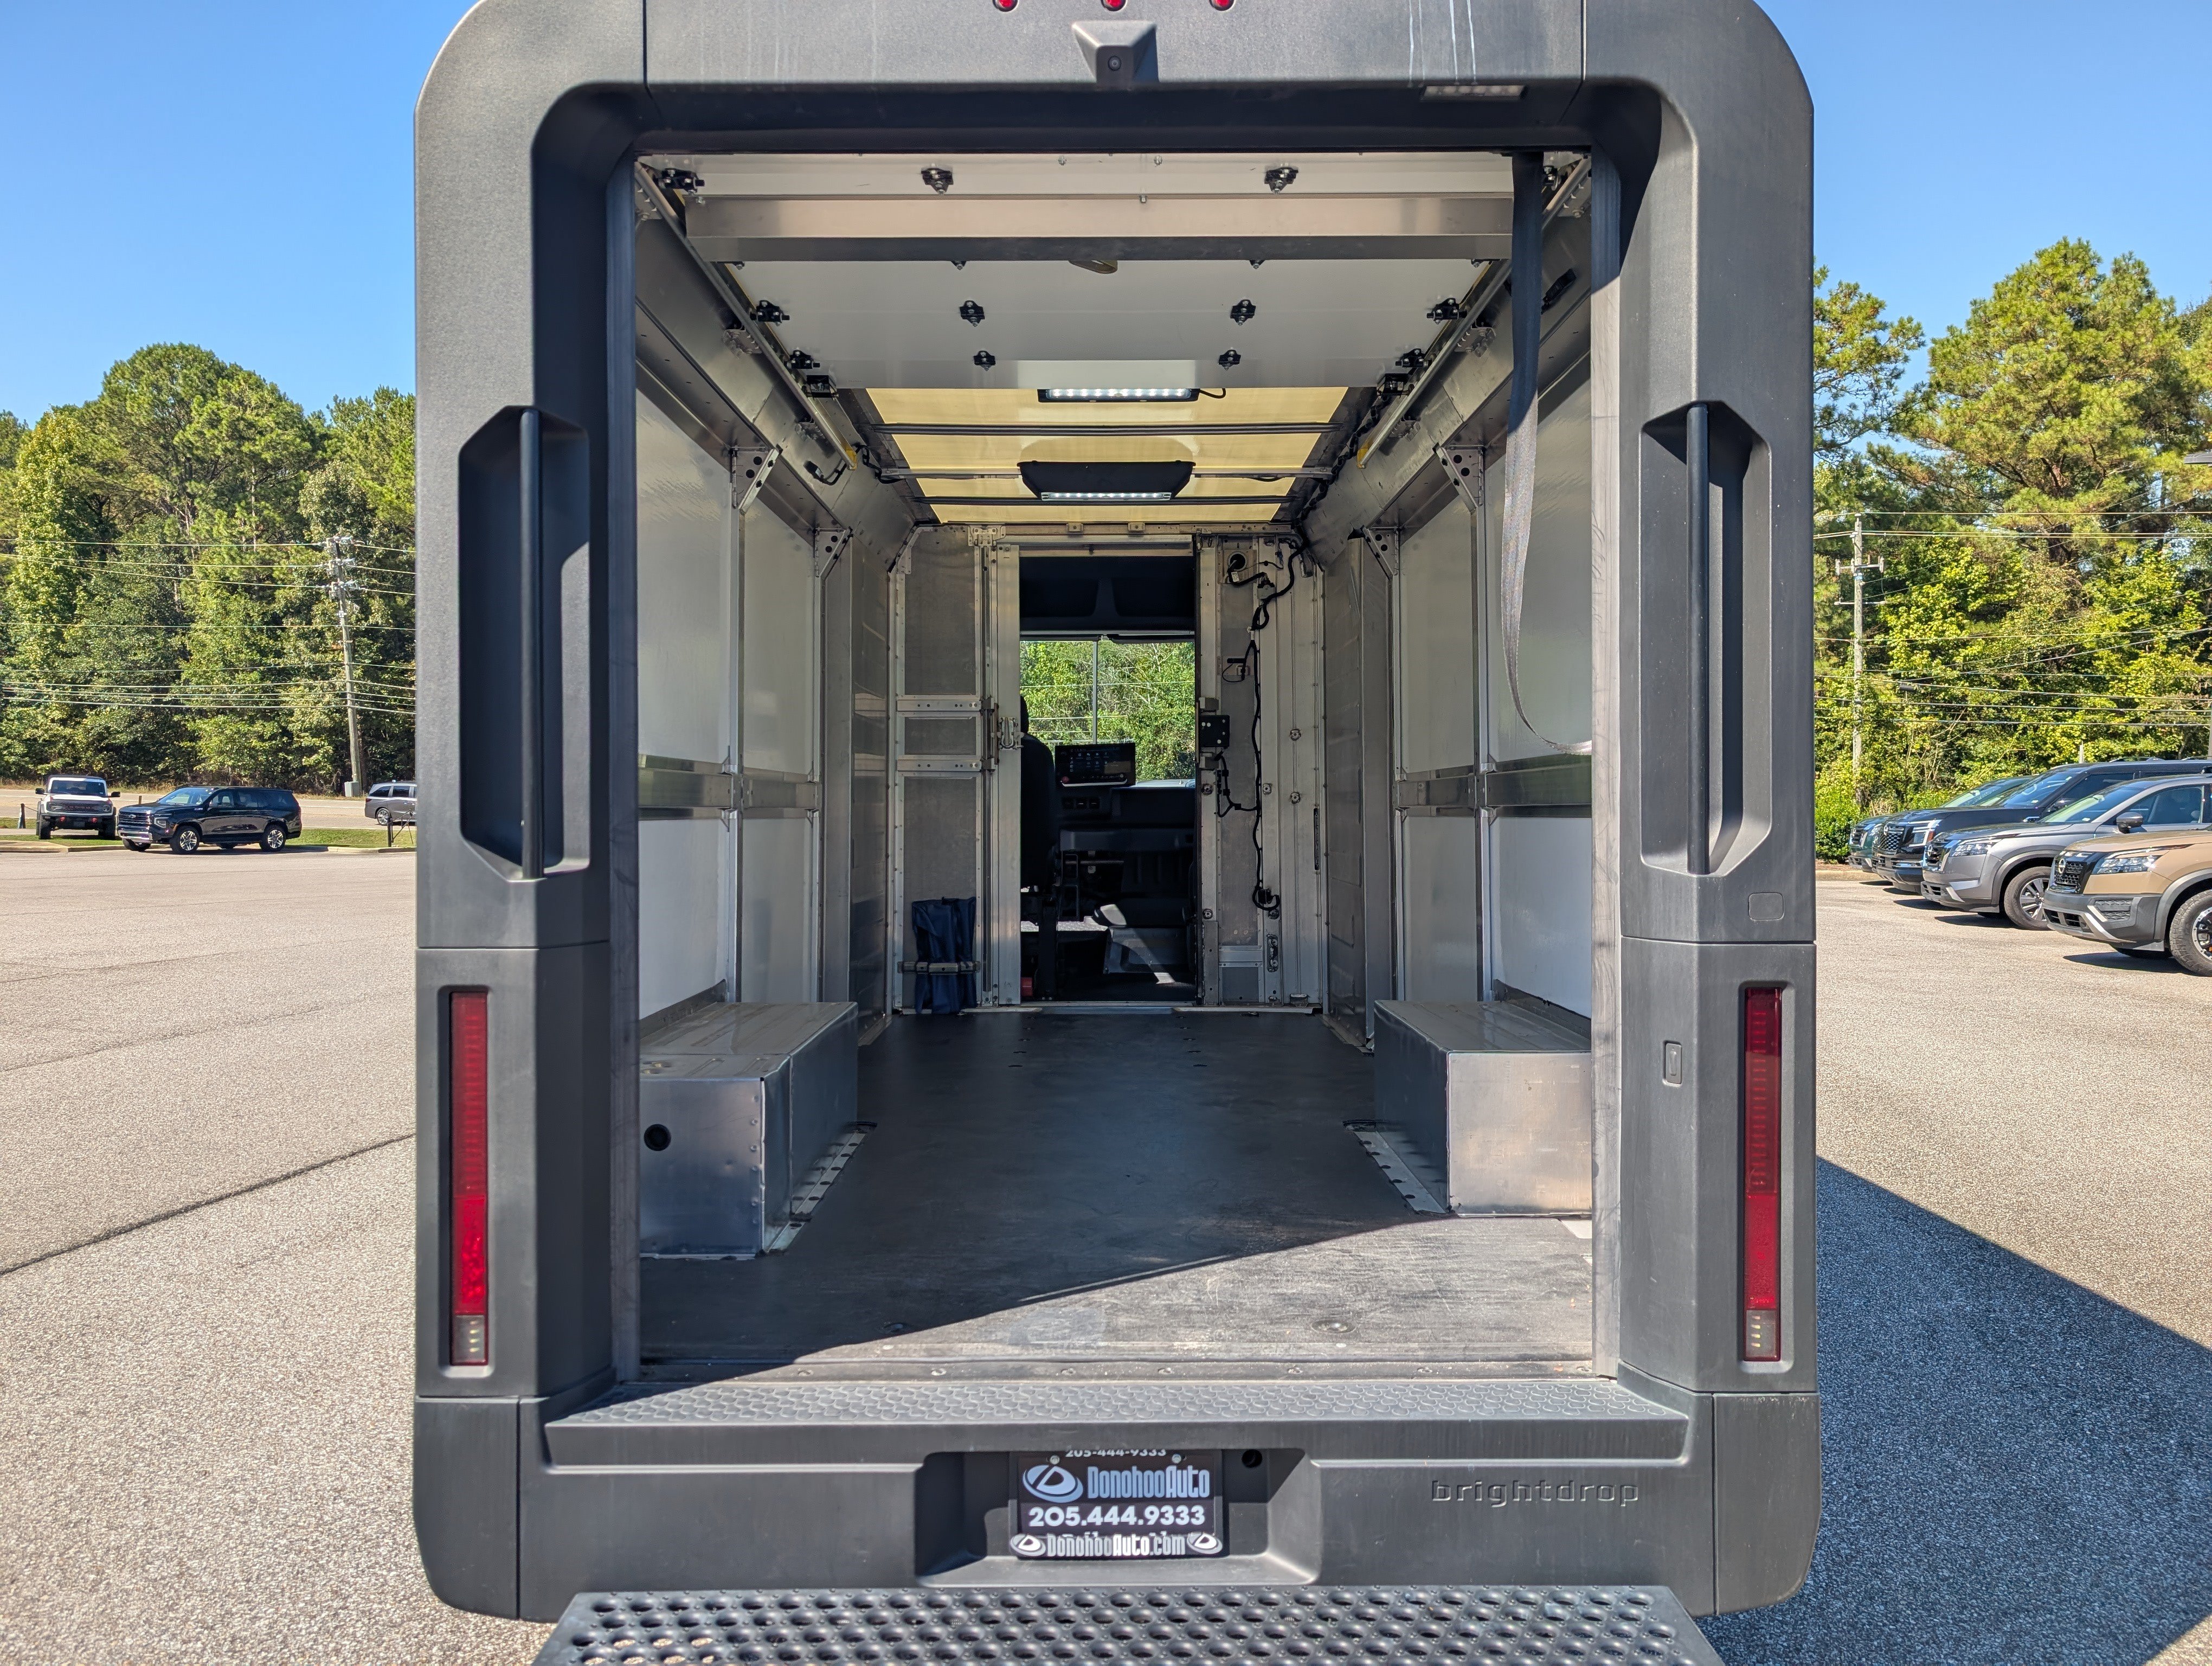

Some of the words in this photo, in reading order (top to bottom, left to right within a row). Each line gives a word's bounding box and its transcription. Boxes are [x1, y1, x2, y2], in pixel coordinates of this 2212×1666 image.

[1088, 1465, 1210, 1498] DonohooAuto
[1432, 1480, 1638, 1508] brightdrop
[1028, 1505, 1205, 1527] 205.444.9333
[1047, 1534, 1186, 1556] DonohooAuto.com
